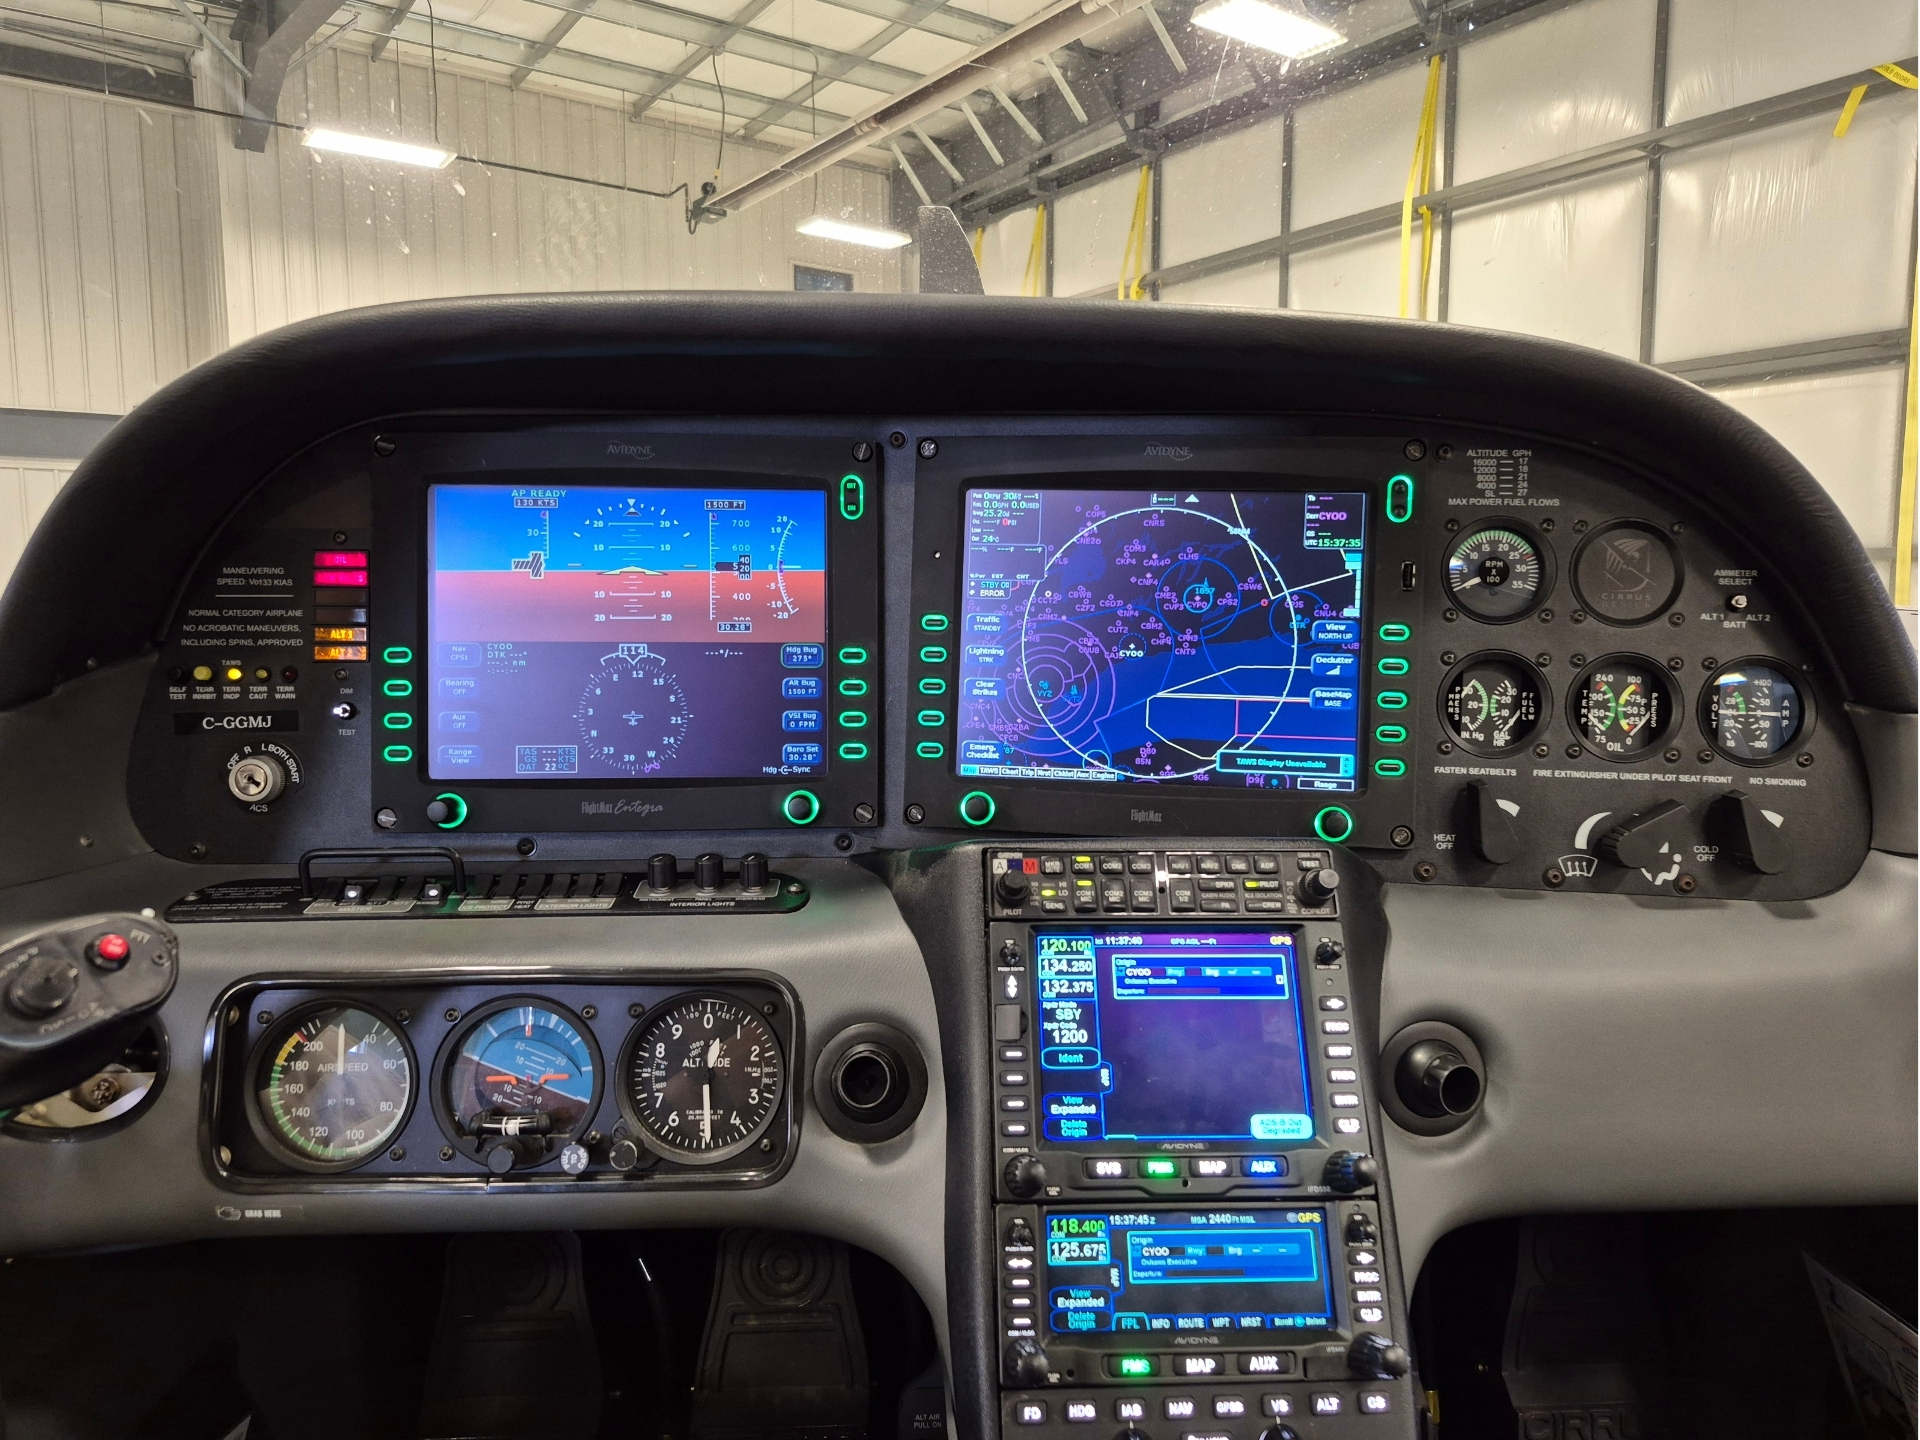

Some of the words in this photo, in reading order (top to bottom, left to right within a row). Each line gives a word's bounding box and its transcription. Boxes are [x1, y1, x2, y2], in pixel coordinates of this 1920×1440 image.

[1466, 449, 1508, 457] ALTITUDE
[1512, 449, 1532, 457] GPH
[1476, 474, 1497, 482] 8000
[1517, 473, 1528, 481] 21
[1476, 482, 1497, 490] 4000
[530, 490, 567, 498] READY
[1484, 490, 1496, 498] SL
[516, 499, 534, 507] 130
[538, 499, 556, 507] KTS
[706, 501, 729, 509] 1500
[733, 501, 744, 509] FT
[1448, 498, 1468, 506] MAX
[1469, 498, 1503, 506] POWER
[1504, 499, 1527, 507] FUEL
[1528, 499, 1560, 507] FLOWS
[1143, 519, 1165, 527] CNR5
[1318, 538, 1361, 547] 15:37:35
[732, 544, 750, 552] 600
[222, 567, 285, 575] MANEUVERING
[1713, 569, 1758, 577] AMMETER
[217, 578, 248, 586] SPEED:
[274, 579, 293, 587] KIAS
[1511, 581, 1524, 589] 35
[1718, 578, 1752, 586] SELECT
[188, 609, 221, 617] NORMAL
[222, 609, 264, 617] CATEGORY
[265, 609, 304, 617] AIRPLANE
[247, 625, 302, 633] MANEUVERS,
[1325, 623, 1346, 631] View
[180, 639, 227, 647] INCLUDING
[228, 639, 255, 648] SPINS,
[257, 639, 304, 647] APPROVED
[622, 646, 645, 655] 114
[786, 646, 800, 655] Hdg
[802, 646, 818, 655] Bug
[969, 648, 1005, 657] Lightning
[1315, 656, 1353, 665] Declutter
[445, 679, 475, 688] Bearing
[1315, 690, 1352, 700] BaseMap
[202, 714, 273, 730] C-GGMJ
[969, 743, 997, 753] Emerg.
[1606, 742, 1624, 752] OIL
[268, 743, 290, 763] BOTH
[966, 752, 1000, 760] Checklist
[1257, 758, 1284, 768] Display
[286, 757, 300, 784] START
[762, 765, 777, 775] Hdg
[792, 765, 811, 775] Sync
[1434, 766, 1467, 775] FASTEN
[1468, 767, 1517, 777] SEATBELTS
[1533, 769, 1553, 777] FIRE
[1554, 770, 1618, 780] EXTINGUISHER
[1619, 772, 1650, 781] UNDER
[1652, 773, 1677, 782] PILOT
[1678, 774, 1701, 783] SEAT
[1702, 775, 1733, 784] FRONT
[1314, 780, 1337, 789] Range
[1749, 777, 1763, 785] NO
[1765, 778, 1807, 787] SMOKING
[249, 804, 268, 812] ACS
[1434, 833, 1456, 842] HEAT
[1436, 842, 1453, 850] OFF
[1693, 845, 1719, 854] COLD
[1697, 854, 1715, 862] OFF
[1301, 860, 1320, 868] TEST
[1041, 938, 1091, 951] 120.100
[1270, 936, 1292, 945] GPS
[1042, 959, 1093, 972] 134.250
[1042, 979, 1094, 993] 132.375
[1055, 1008, 1082, 1020] SBY
[703, 1013, 714, 1029] 0
[671, 1024, 683, 1040] 9
[1052, 1029, 1088, 1043] 1200
[364, 1034, 377, 1044] 40
[303, 1041, 323, 1052] 200
[655, 1042, 665, 1058] 8
[750, 1045, 760, 1061] 2
[1058, 1053, 1084, 1063] Ident
[290, 1060, 309, 1071] 180
[383, 1059, 396, 1069] 60
[284, 1083, 303, 1094] 160
[654, 1092, 664, 1109] 7
[748, 1088, 759, 1104] 3
[1062, 1095, 1083, 1105] View
[380, 1101, 393, 1112] 80
[1051, 1104, 1096, 1116] Expanded
[291, 1107, 310, 1117] 140
[668, 1111, 680, 1127] 6
[730, 1110, 741, 1126] 4
[1060, 1119, 1087, 1128] Delete
[309, 1126, 328, 1137] 120
[346, 1129, 365, 1140] 100
[1061, 1128, 1087, 1138] Origin
[1198, 1160, 1227, 1174] MAP
[1250, 1160, 1277, 1173] AUX
[1297, 1212, 1321, 1223] GPS
[1051, 1218, 1106, 1233] 118.400
[1131, 1236, 1153, 1245] Origin
[1051, 1242, 1107, 1258] 125.675
[1142, 1247, 1169, 1257] CYOO
[1069, 1288, 1092, 1298] View
[1057, 1297, 1105, 1310] Expanded
[1068, 1310, 1096, 1320] Delete
[1068, 1319, 1096, 1331] Origin
[1121, 1318, 1140, 1329] FPL
[1152, 1318, 1170, 1329] INFO
[1178, 1317, 1205, 1328] ROUTE
[1212, 1317, 1230, 1328] WPT
[1241, 1316, 1262, 1328] NRST
[1186, 1357, 1216, 1373] MAP
[1250, 1356, 1279, 1371] AUX
[1168, 1401, 1193, 1415] NAV
[1316, 1397, 1339, 1411] ALT
[1023, 1406, 1041, 1420] FD
[1069, 1404, 1095, 1418] HDG
